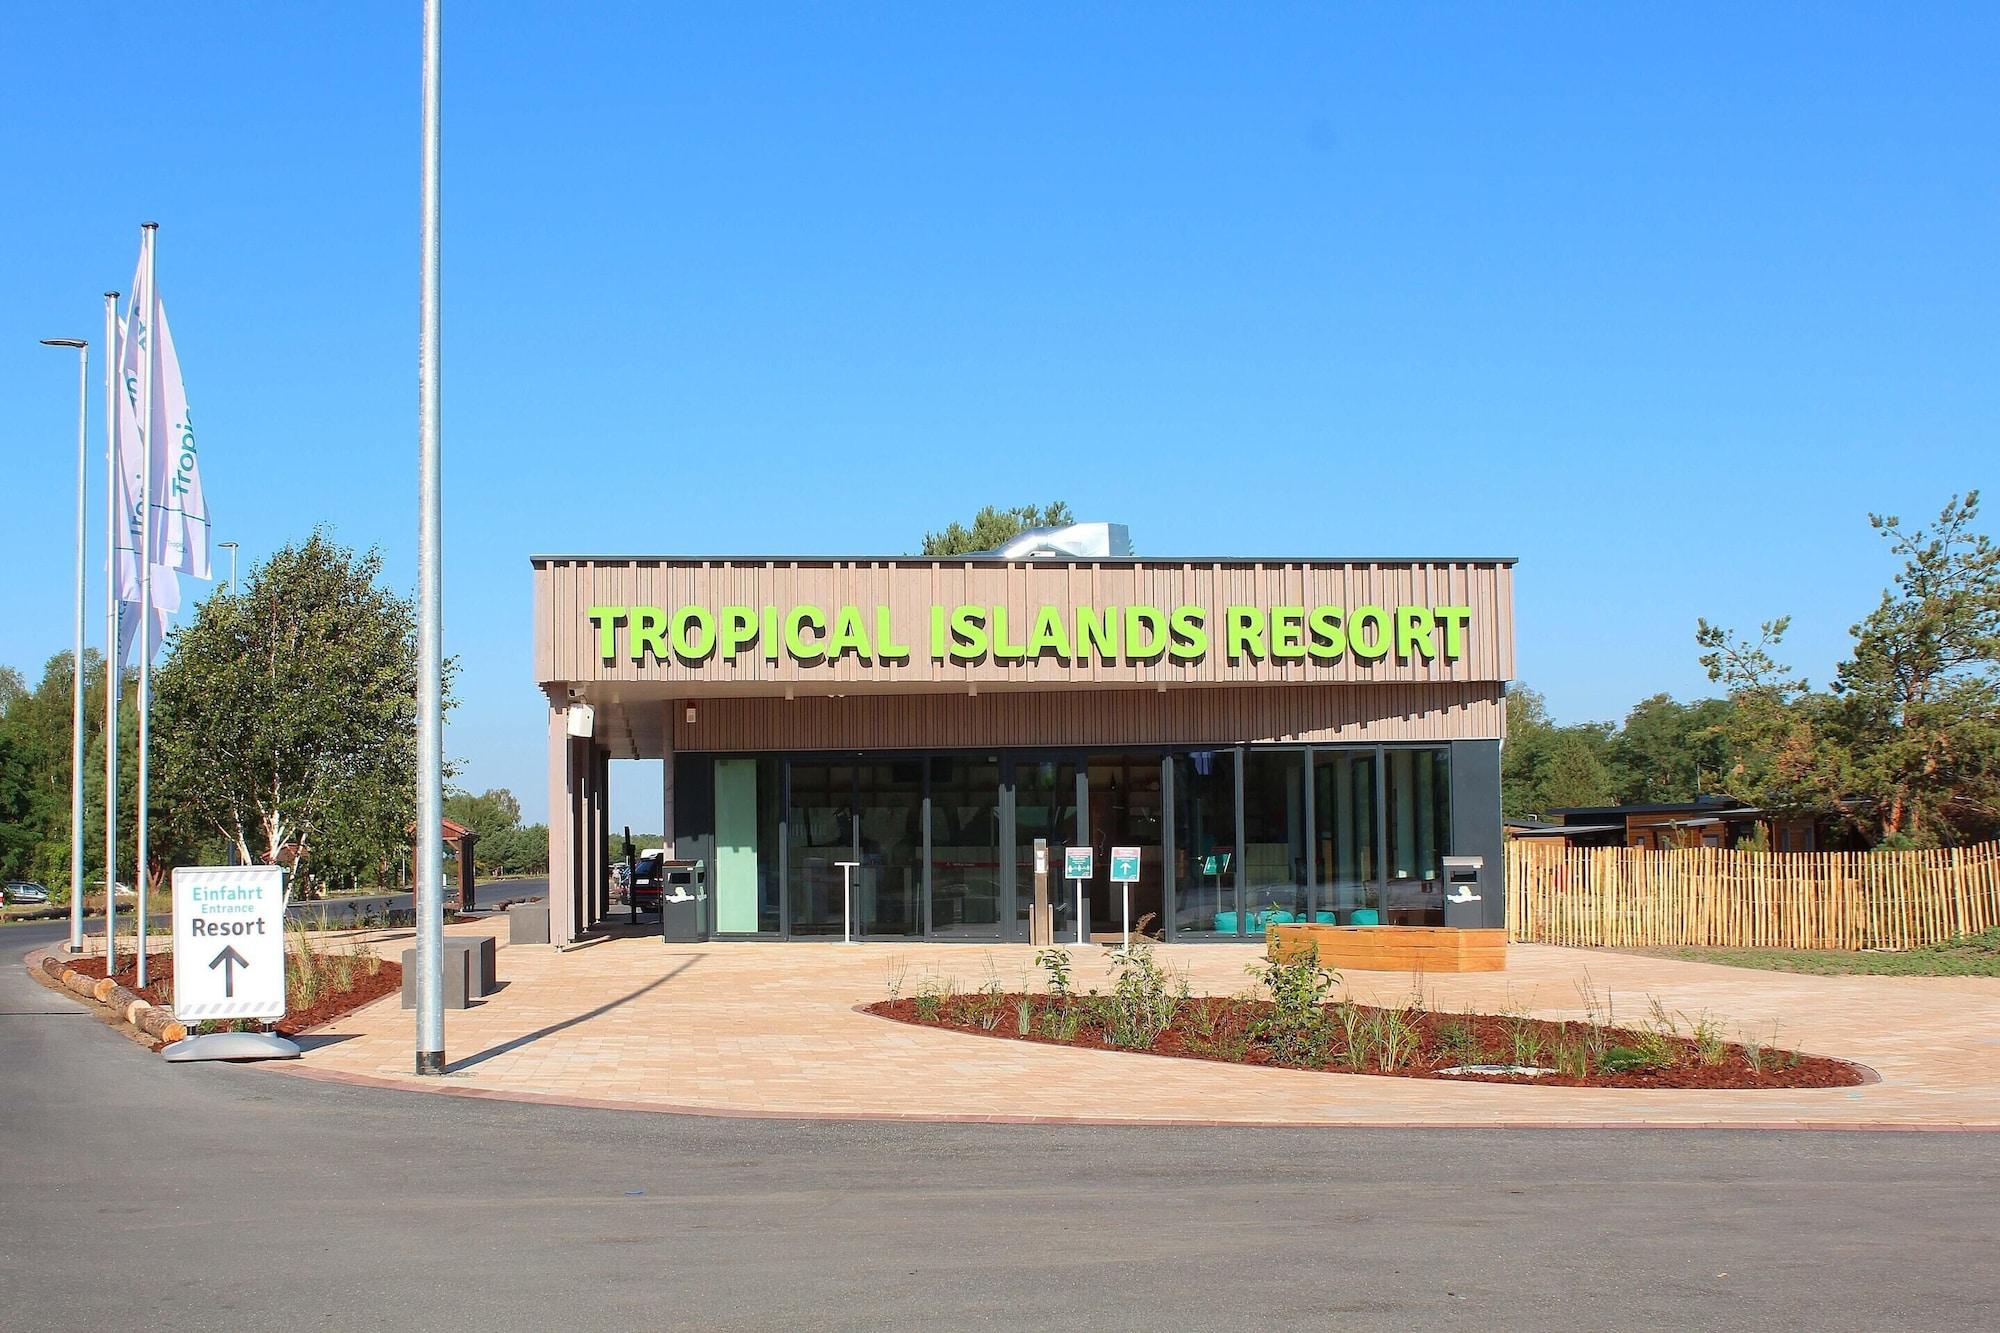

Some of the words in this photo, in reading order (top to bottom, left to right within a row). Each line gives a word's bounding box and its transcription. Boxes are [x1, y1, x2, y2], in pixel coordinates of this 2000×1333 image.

[588, 605, 910, 659] TROPICAL
[931, 605, 1209, 659] ISLANDS
[1228, 605, 1472, 659] RESORT
[192, 884, 263, 902] Einfahrt
[201, 903, 255, 914] Entrance
[192, 917, 265, 937] Resort
